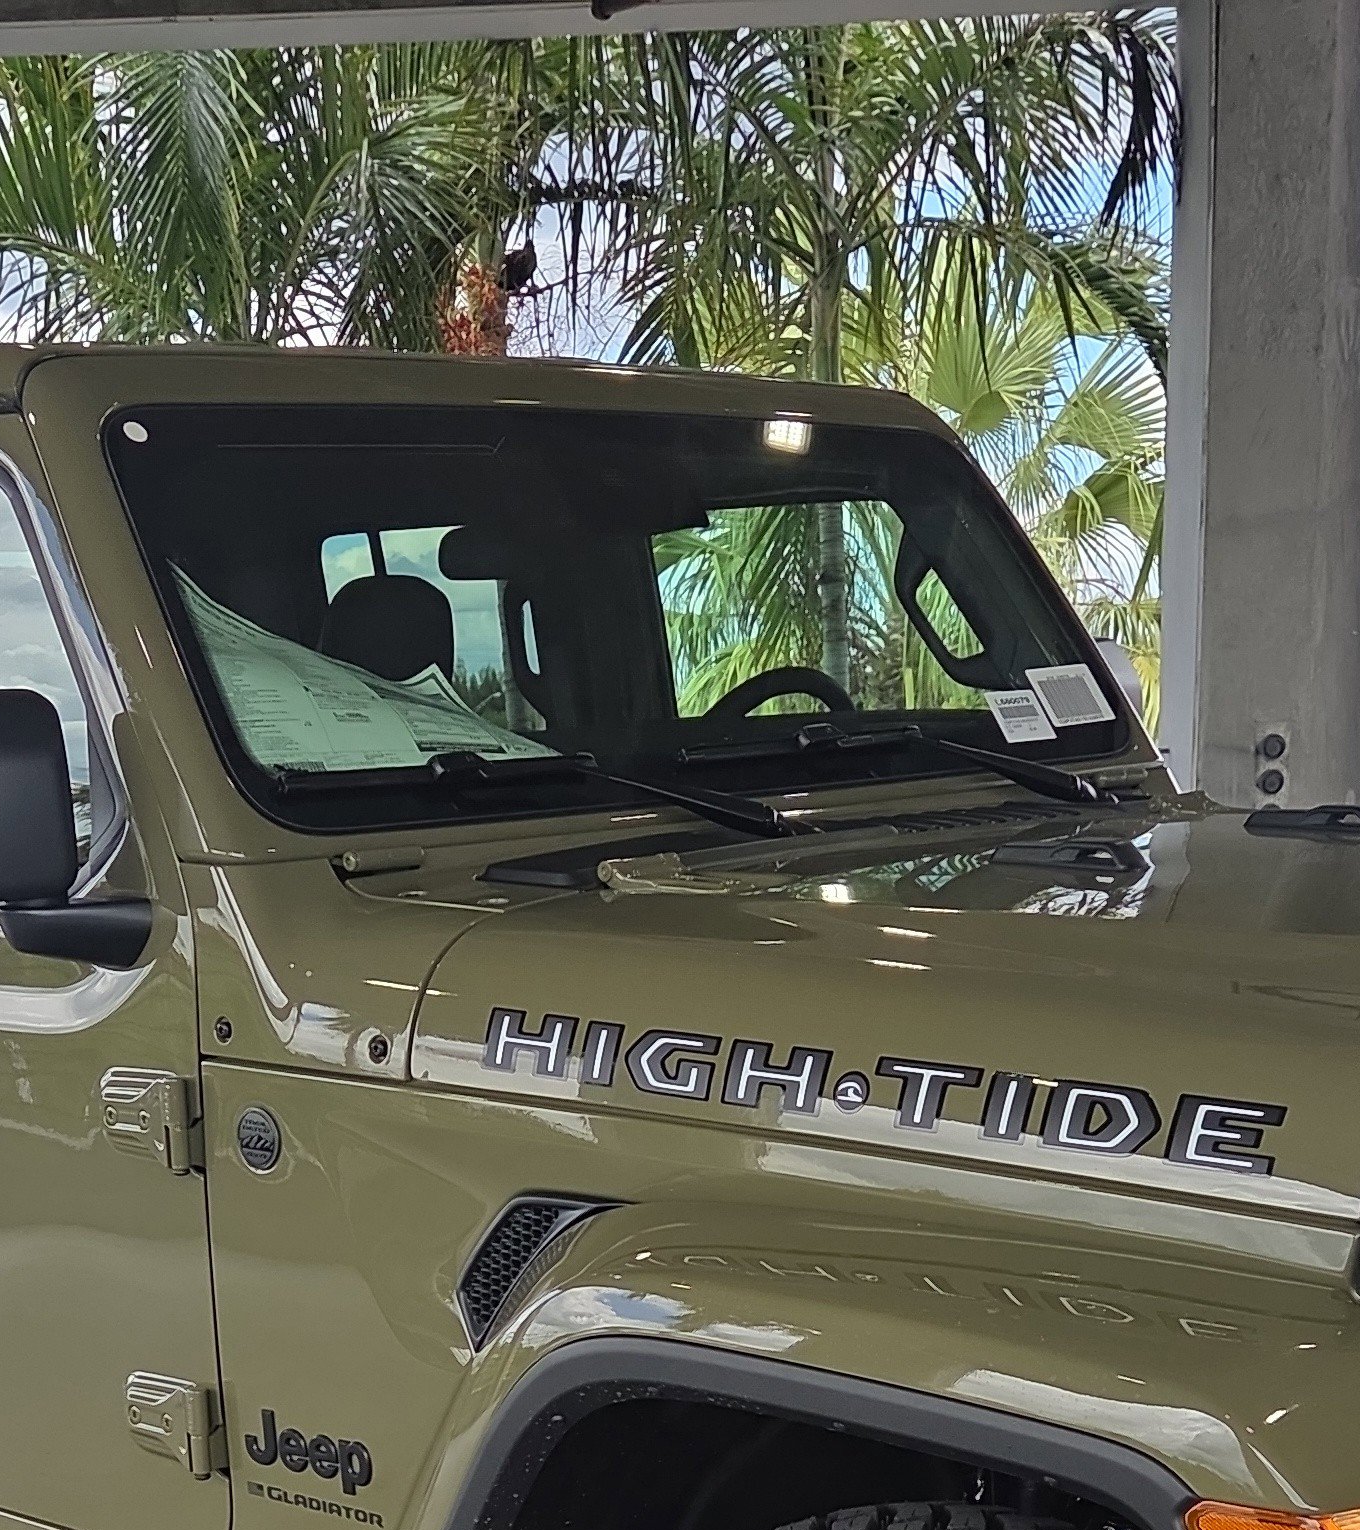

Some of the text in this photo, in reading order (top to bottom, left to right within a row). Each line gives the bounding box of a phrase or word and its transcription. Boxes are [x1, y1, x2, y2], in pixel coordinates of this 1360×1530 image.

[483, 1007, 1288, 1176] HIGH TIDE
[244, 1408, 373, 1496] Jeep
[267, 1485, 384, 1529] GLADIATOR
